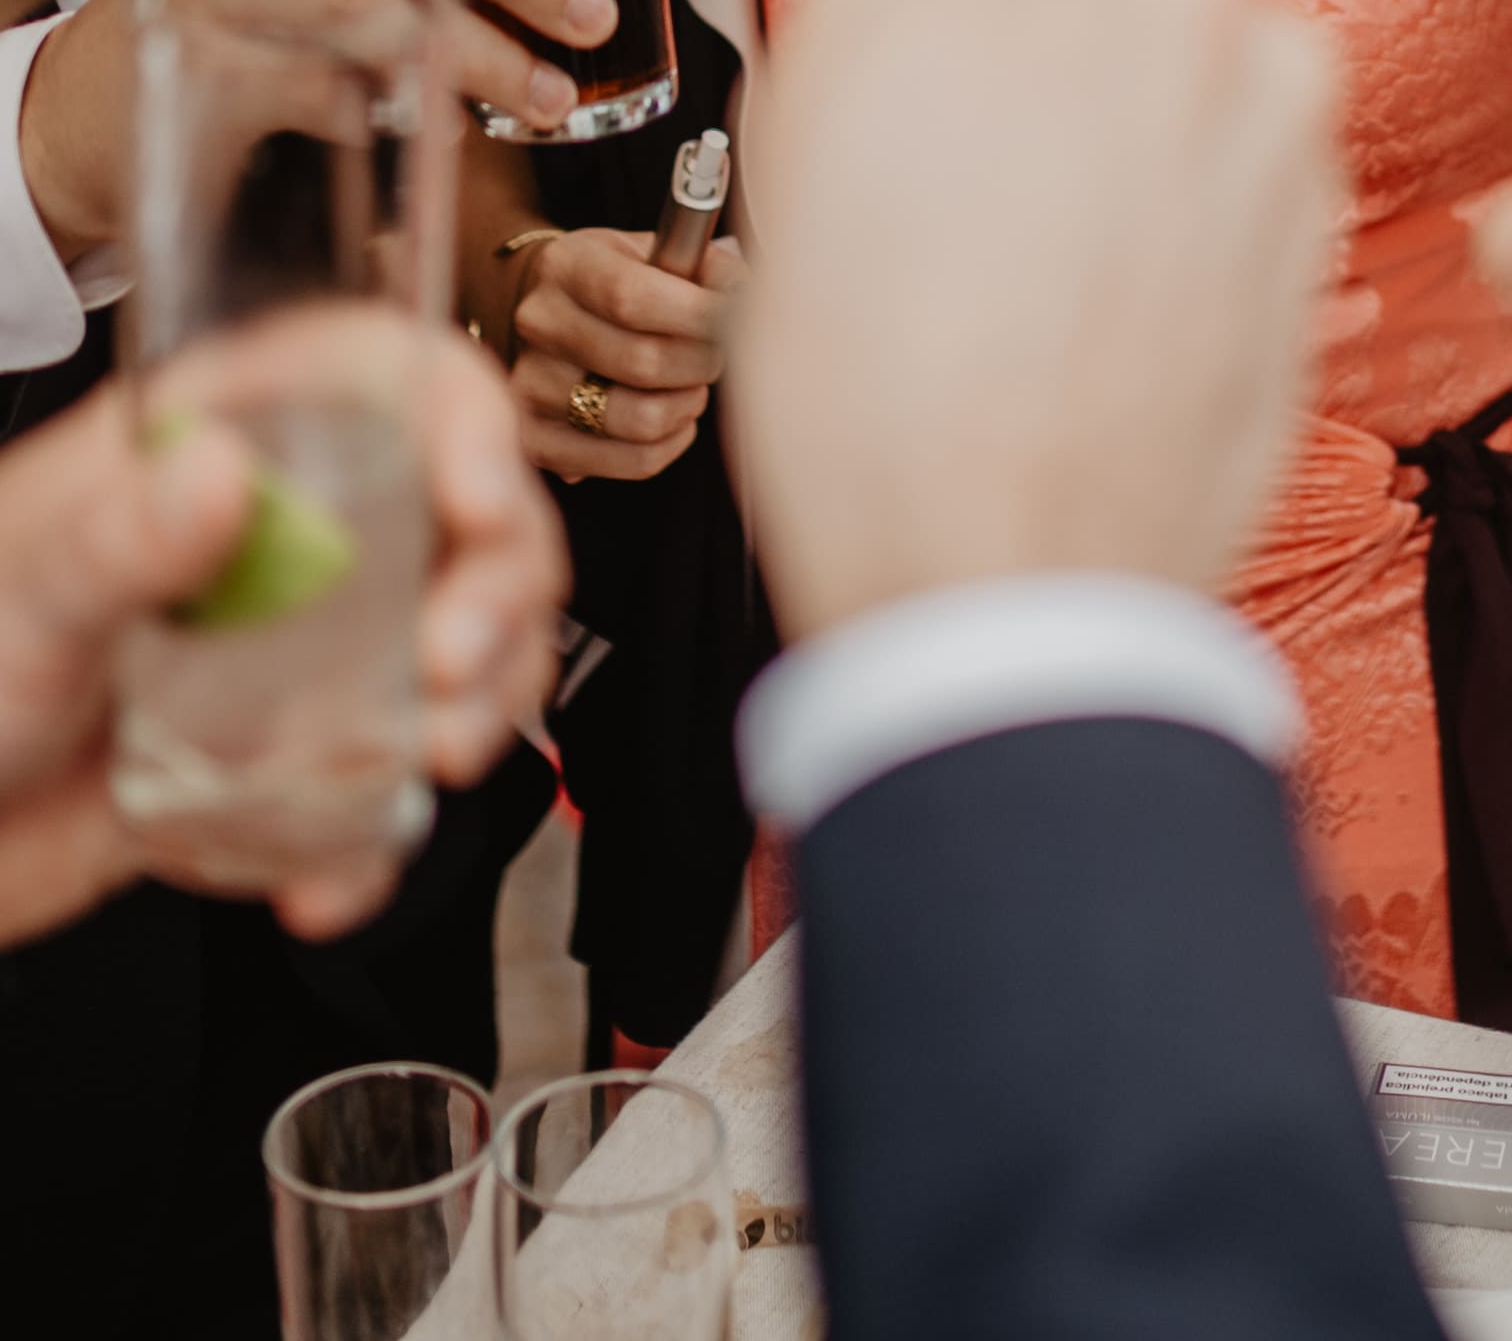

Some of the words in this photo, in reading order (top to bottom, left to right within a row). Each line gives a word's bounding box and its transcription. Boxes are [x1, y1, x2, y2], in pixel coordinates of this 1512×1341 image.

[1394, 1071, 1491, 1086] dependência.
[1386, 1081, 1454, 1093] prejudica
[1458, 1088, 1508, 1099] tabaco
